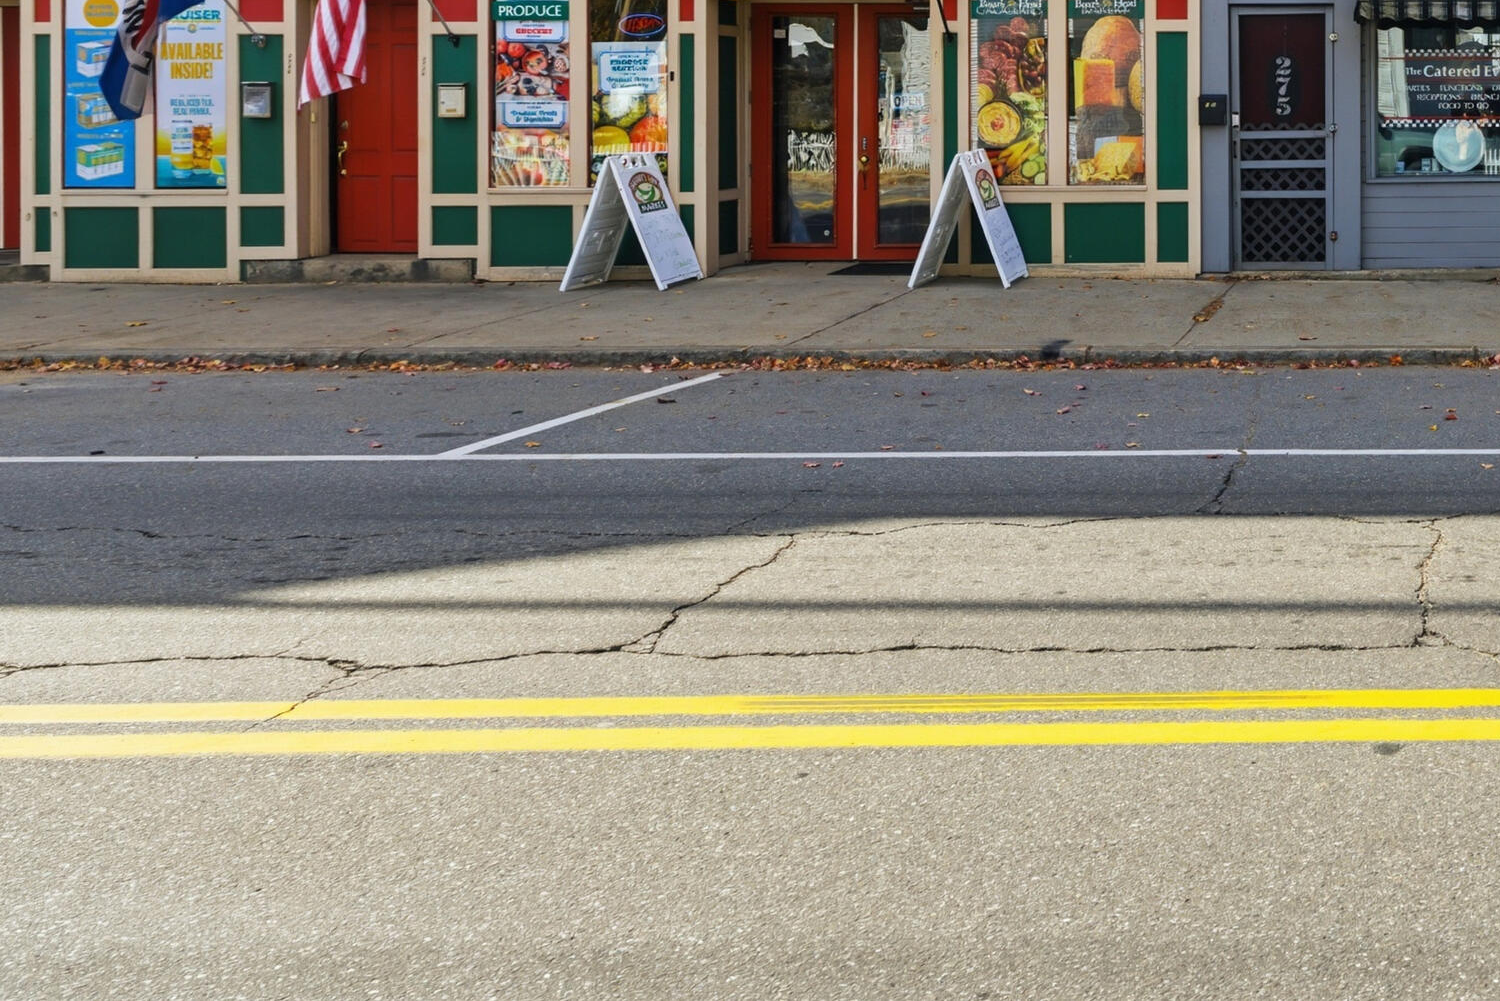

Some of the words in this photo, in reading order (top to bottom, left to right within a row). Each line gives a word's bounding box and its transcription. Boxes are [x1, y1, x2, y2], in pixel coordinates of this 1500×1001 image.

[498, 5, 562, 17] PRODUCE
[160, 42, 224, 61] AVAILABLE
[170, 62, 213, 79] INSIDE!
[1405, 67, 1422, 76] The
[1423, 65, 1481, 78] Catered
[1275, 56, 1292, 116] 275
[894, 95, 923, 108] OPEN
[1438, 102, 1461, 110] FOOD
[1463, 102, 1475, 110] TO
[1476, 102, 1490, 110] GO
